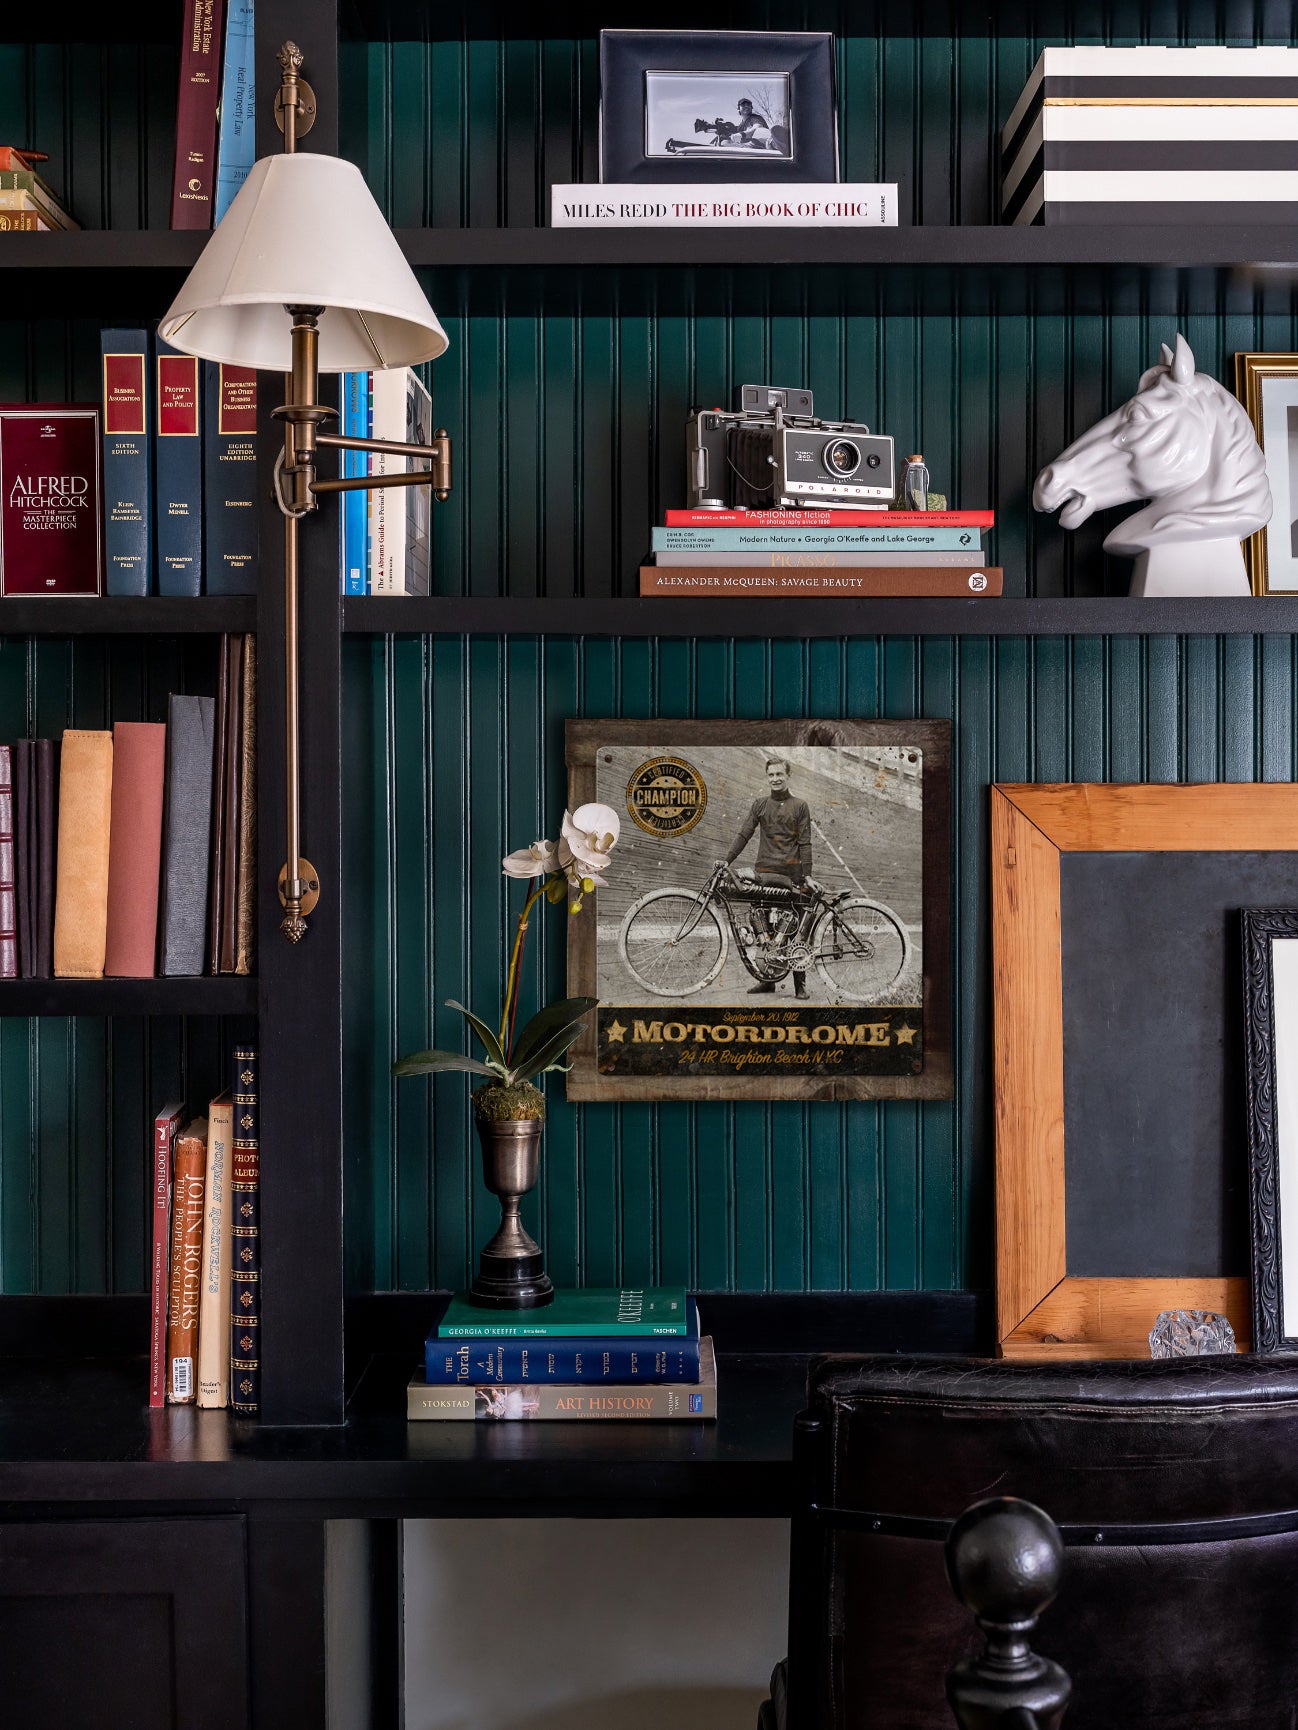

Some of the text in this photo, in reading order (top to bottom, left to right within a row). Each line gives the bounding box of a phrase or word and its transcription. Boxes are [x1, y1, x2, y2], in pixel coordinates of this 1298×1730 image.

[202, 0, 214, 54] New York Estate
[233, 66, 246, 136] Real Property Law
[247, 103, 256, 120] York
[180, 192, 208, 201] LexisNexis
[563, 202, 868, 218] MILES REDD THE BIG BOOK OF CHIC
[10, 475, 88, 497] ALFRED
[798, 485, 881, 494] POLAROID
[10, 496, 88, 508] HITCHCOCK
[22, 515, 76, 523] MASTERPIECE
[804, 535, 835, 545] Georgia
[907, 536, 935, 544] George
[771, 553, 837, 567] PICASSO
[657, 578, 863, 587] ALEXANDER McQUEEN: SAVAGE BEAUTY
[648, 766, 686, 779] CERTIFIED
[637, 790, 696, 804] CHAMPION
[722, 1012, 765, 1023] September
[781, 1012, 799, 1022] 1912
[632, 1020, 891, 1046] MOTORDROME
[678, 1050, 696, 1064] 24
[698, 1050, 719, 1064] HR
[720, 1050, 772, 1070] Brighton
[774, 1050, 811, 1064] Beach
[157, 1146, 166, 1209] HOOFING IT!
[185, 1173, 204, 1234] JOHN
[209, 1141, 224, 1294] NORMAN ROCKWELL'S
[170, 1178, 185, 1327] THE PEOPLE'S SCULPTOR
[182, 1244, 201, 1330] ROGERS
[617, 1290, 643, 1322] O'KEEFFE
[457, 1346, 469, 1382] Torah
[486, 1354, 494, 1376] Modern
[422, 1400, 469, 1408] STOKSTAD
[555, 1398, 653, 1409] ART HISTORY
